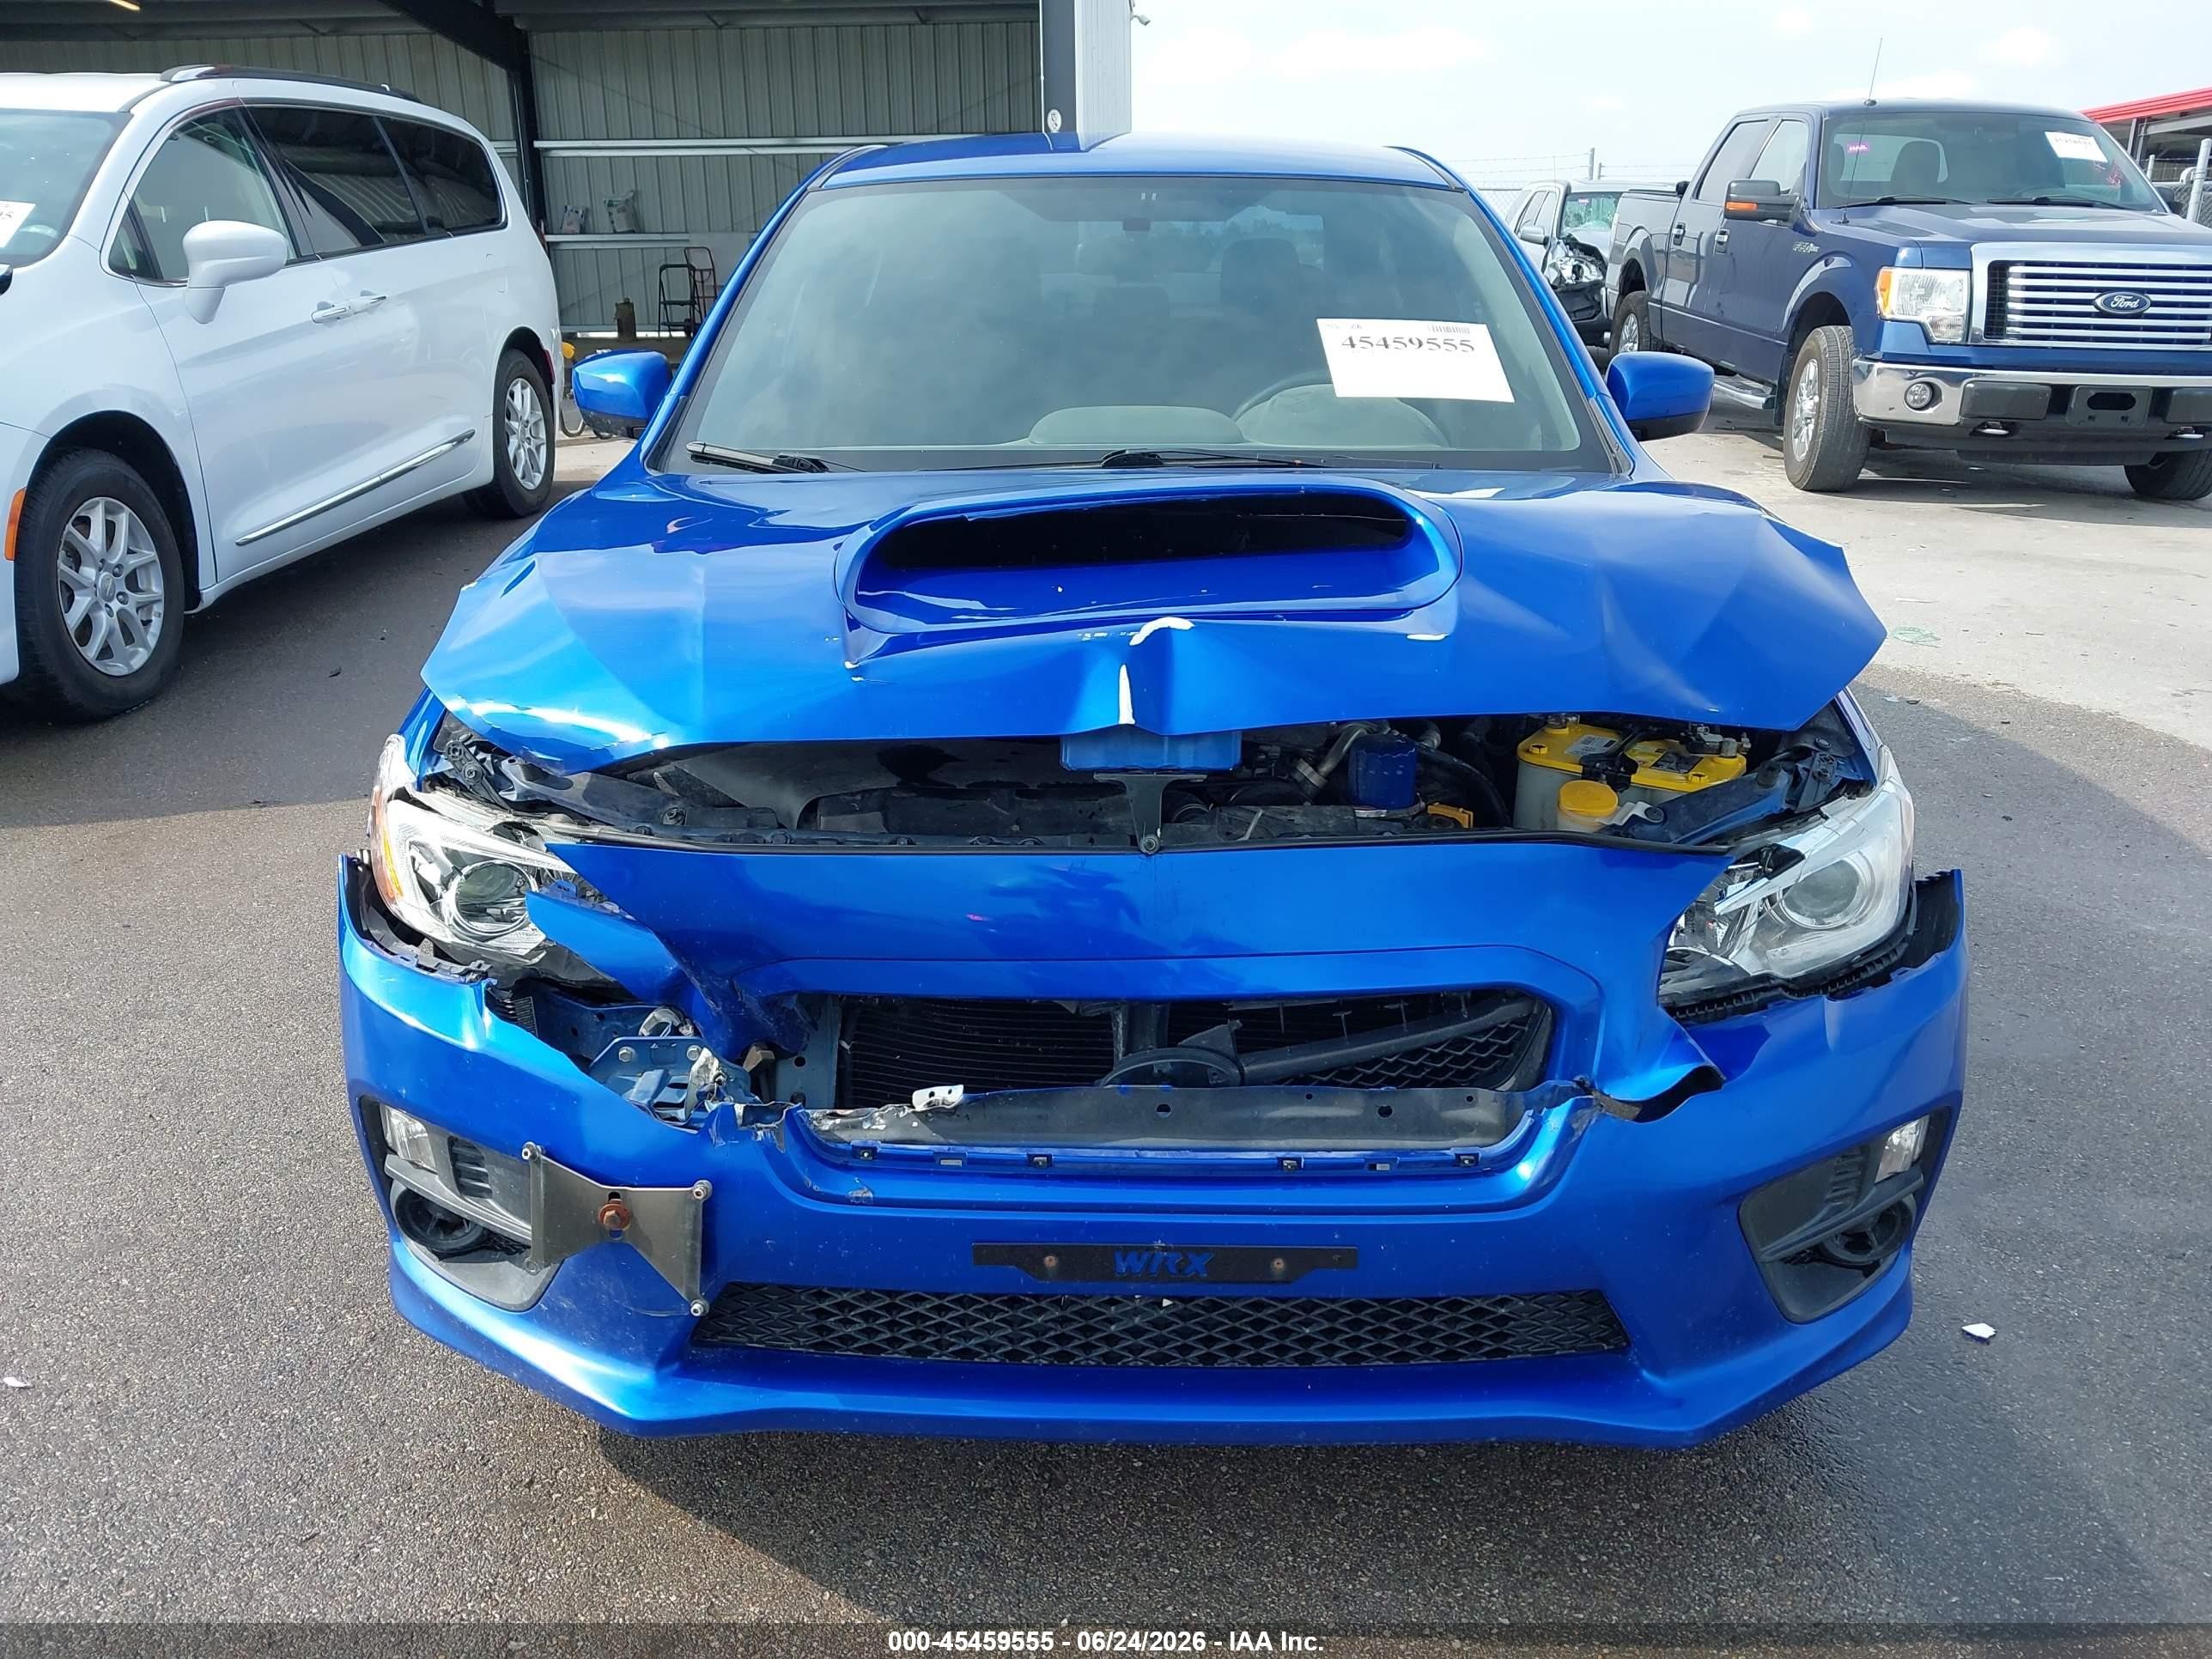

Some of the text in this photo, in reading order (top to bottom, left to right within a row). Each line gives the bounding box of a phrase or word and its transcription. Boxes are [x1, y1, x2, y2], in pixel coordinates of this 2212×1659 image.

[2111, 295, 2141, 309] Ford
[1341, 336, 1475, 353] 45459555
[1114, 1250, 1214, 1277] WRX
